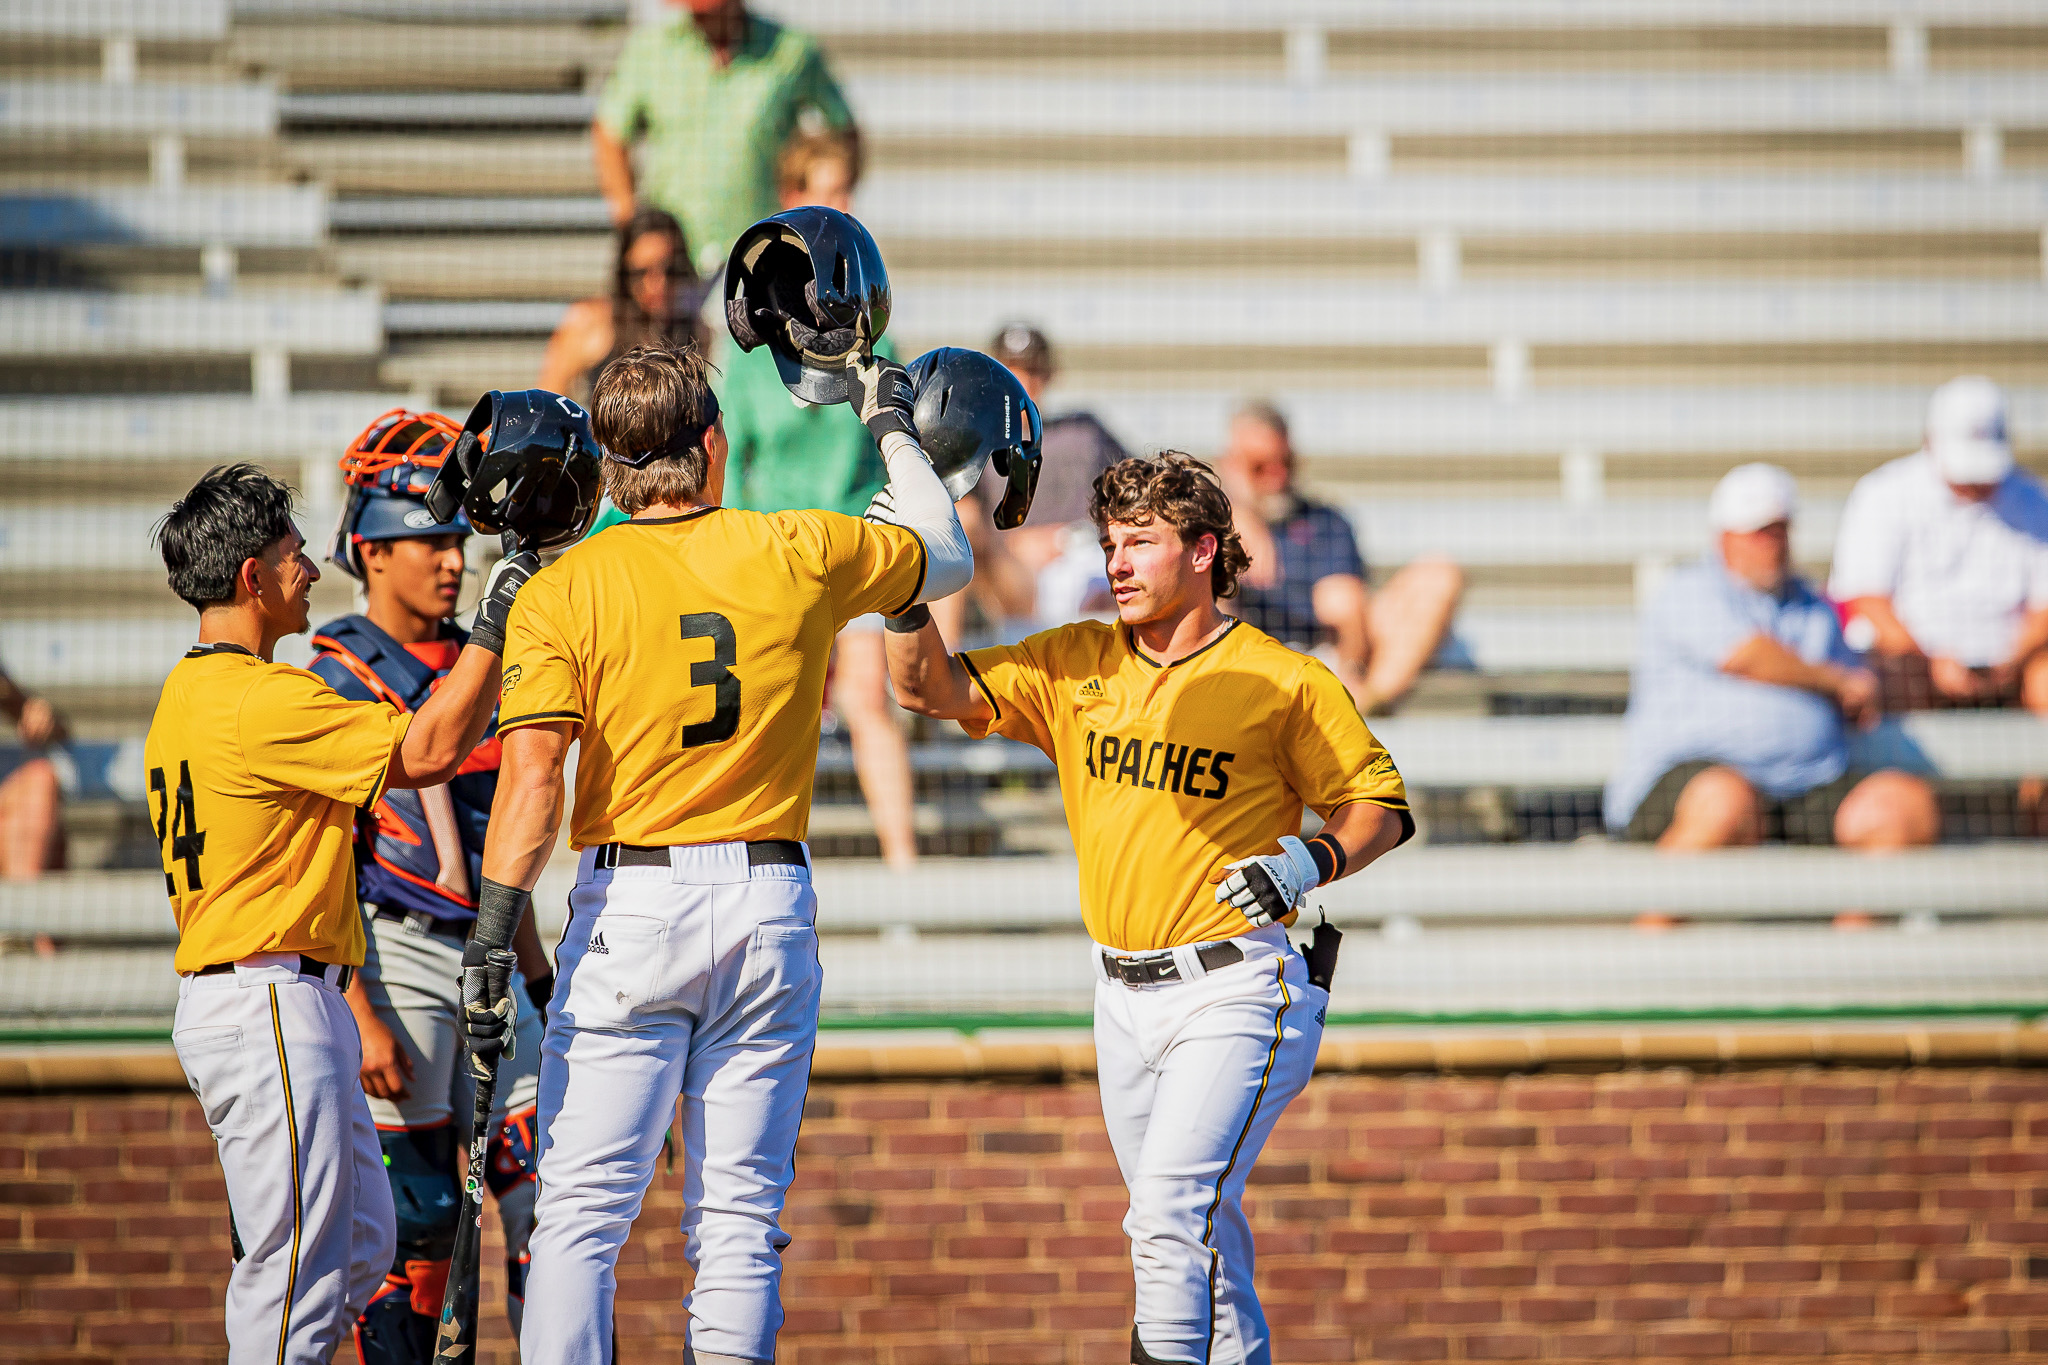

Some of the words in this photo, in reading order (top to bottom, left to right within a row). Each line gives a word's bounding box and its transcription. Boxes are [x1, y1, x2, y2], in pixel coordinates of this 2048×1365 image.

[680, 612, 741, 749] 3
[1079, 689, 1103, 697] adidas
[1086, 730, 1236, 800] APACHES
[150, 760, 206, 897] 24
[1264, 863, 1292, 903] EASTON
[587, 944, 609, 955] adidas
